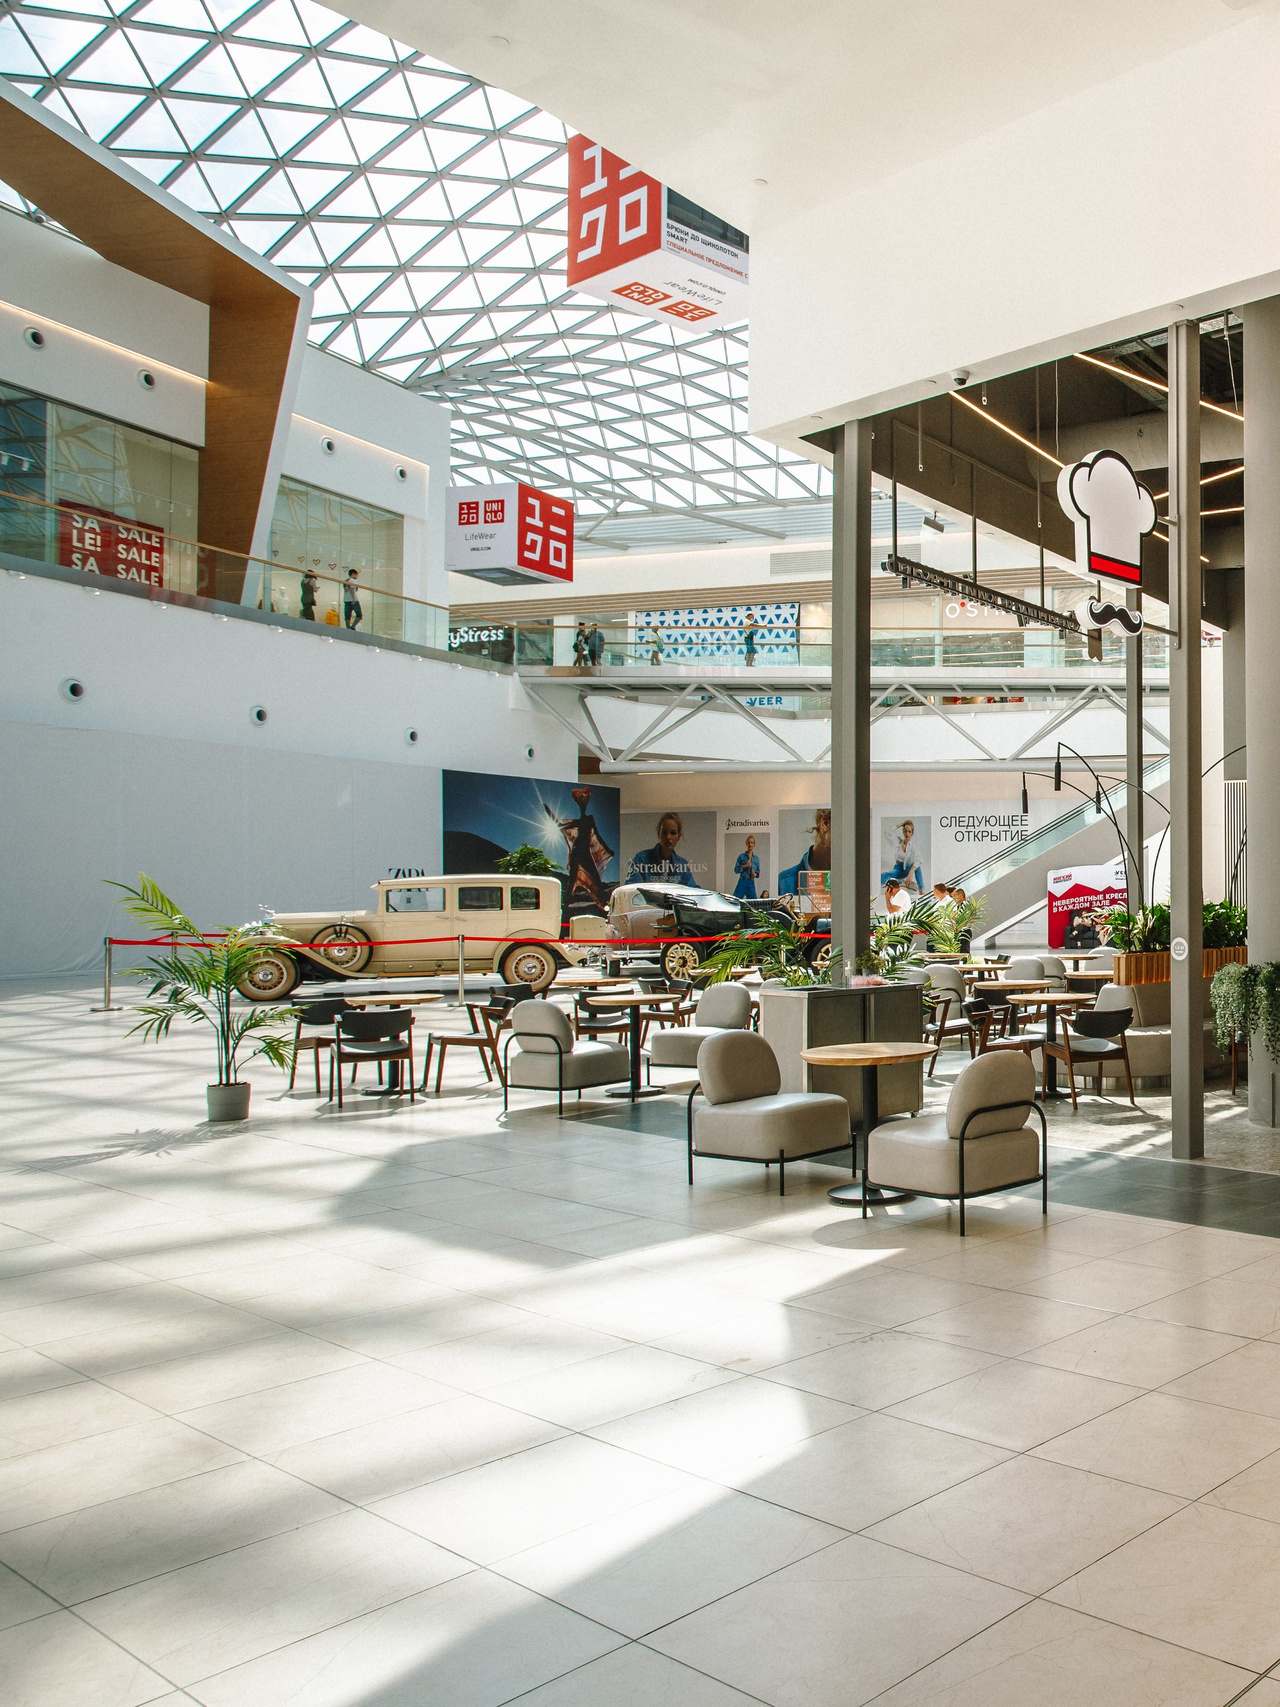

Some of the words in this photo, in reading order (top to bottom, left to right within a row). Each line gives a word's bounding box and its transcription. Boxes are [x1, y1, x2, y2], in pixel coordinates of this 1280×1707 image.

[666, 231, 688, 244] SMART
[666, 222, 690, 238] БРЮКИ
[690, 232, 699, 242] ДО
[700, 236, 739, 259] ЩИКОЛОТОК
[666, 240, 705, 260] СПЕЦИАЛЬНОЕ
[705, 255, 743, 277] ПРЕДЛОЖЕНИЕ
[622, 289, 654, 304] UNI
[630, 284, 665, 301] QLO
[663, 280, 723, 306] LifeWear
[485, 502, 502, 512] UNI
[72, 513, 100, 532] SA
[485, 512, 502, 522] QLO
[72, 529, 102, 552] LE!
[117, 526, 160, 547] SALE
[464, 532, 496, 541] LifeWear
[117, 543, 160, 568] SALE
[71, 553, 100, 574] SA
[117, 564, 160, 587] SALE
[746, 696, 783, 707] VEER
[731, 818, 770, 827] stradivarius
[939, 815, 1029, 829] СЛЕДУЮЩЕЕ
[954, 830, 1029, 842] ОТКРЫТИЕ
[635, 859, 708, 873] stradivarius
[1052, 893, 1104, 907] НЕВЕРОЯТНЫЕ
[1059, 902, 1090, 912] КАЖДОМ
